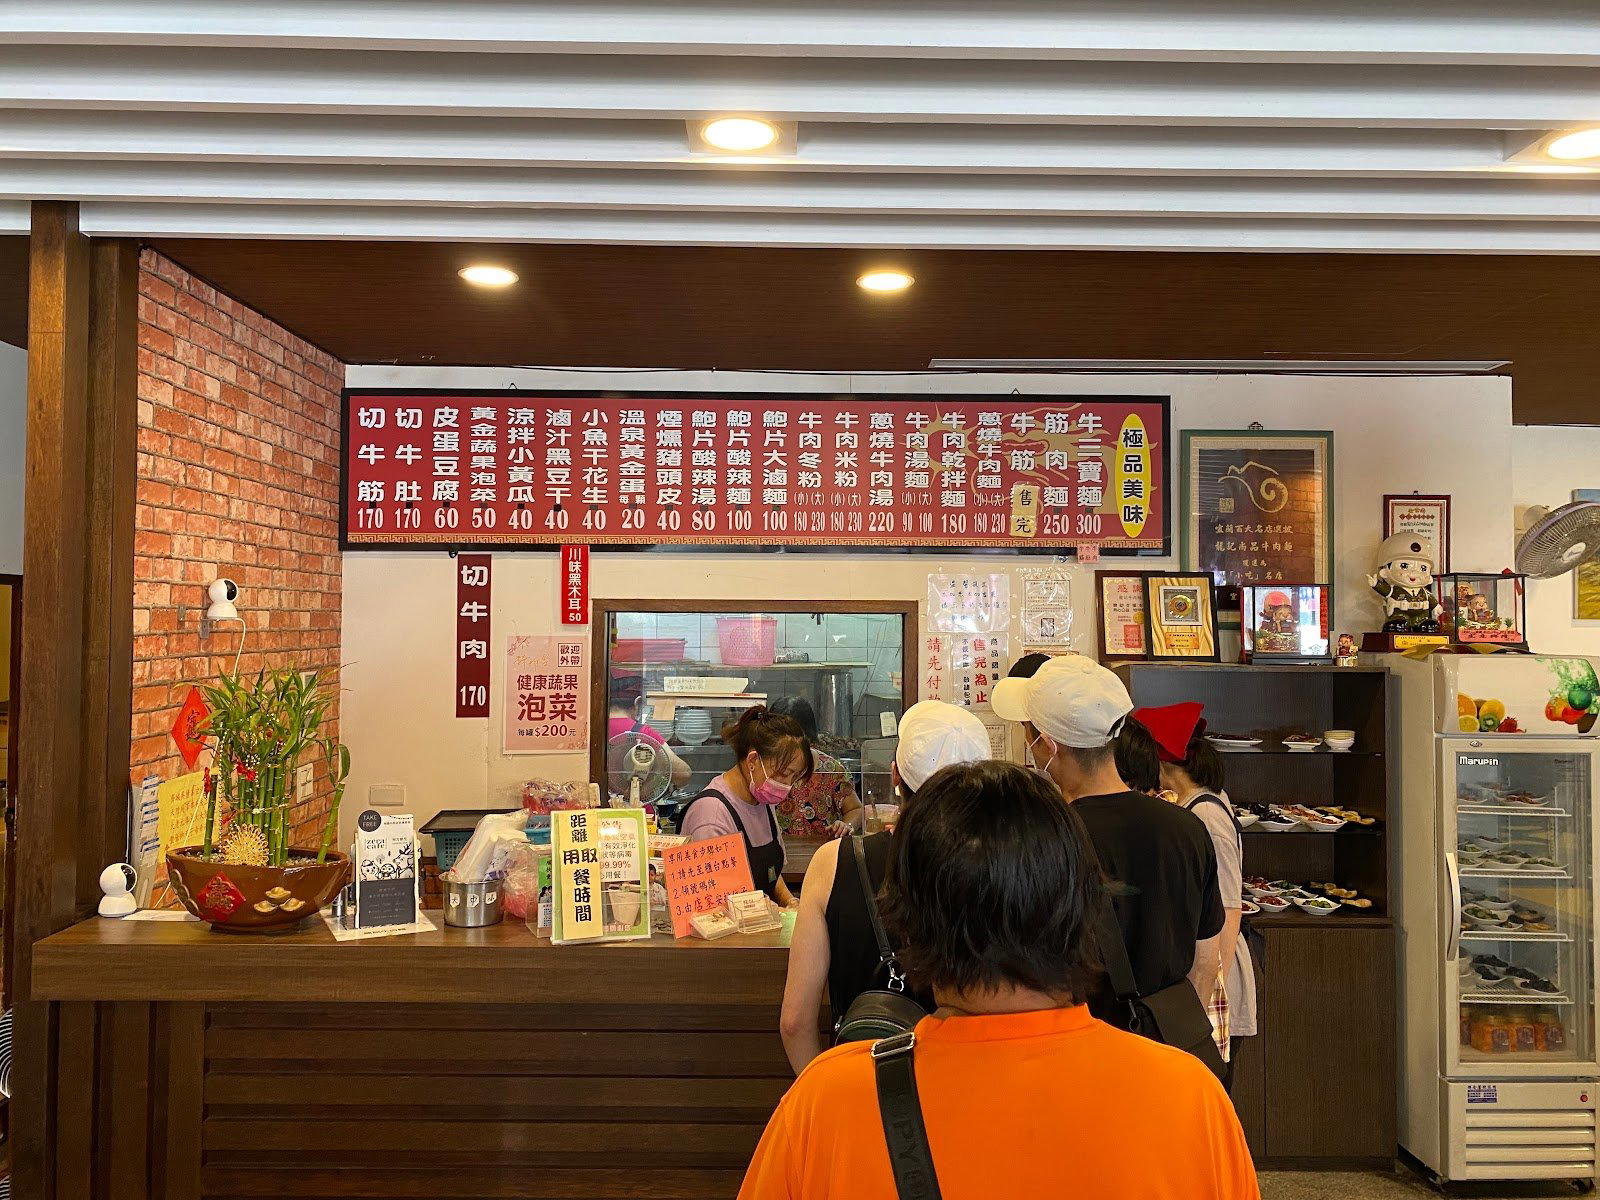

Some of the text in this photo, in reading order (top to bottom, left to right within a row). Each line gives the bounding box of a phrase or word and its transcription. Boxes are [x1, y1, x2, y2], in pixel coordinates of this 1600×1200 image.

[432, 406, 460, 529] 皮蛋豆腐 60
[619, 409, 647, 493] 溫泉黃金蛋
[798, 411, 823, 488] 牛肉冬粉
[834, 411, 860, 488] 牛肉米粉
[904, 411, 930, 488] 牛肉湯麵
[976, 412, 1003, 489] 蔥燒牛肉麵
[1076, 412, 1103, 507] 牛三寶麵
[357, 407, 386, 529] 切牛筋 170
[394, 407, 423, 529] 切牛肚 170
[507, 407, 536, 530] 涼拌小黃瓜 40
[544, 408, 572, 530] 滷汁黑豆干 40
[582, 408, 609, 530] 小魚干花生 40
[656, 410, 683, 531] 煙燻豬頭皮 40
[691, 410, 717, 531] 鮑片酸辣湯 80
[1043, 412, 1070, 535] 筋肉麵 250
[1122, 428, 1144, 524] 極品美味
[471, 507, 497, 529] 50
[621, 508, 646, 529] 20
[726, 510, 752, 531] 100
[762, 510, 788, 531] 100
[793, 511, 808, 532] 180
[811, 511, 826, 532] 230
[830, 511, 844, 532] 180
[848, 511, 862, 532] 230
[868, 511, 895, 532] 220
[902, 511, 913, 532] 90
[918, 512, 933, 532] 100
[941, 513, 967, 534] 180
[973, 512, 988, 533] 180
[991, 513, 1006, 534] 230
[1015, 489, 1032, 533] 售完
[1076, 513, 1102, 535] 300
[568, 547, 583, 622] 川味黑木耳 50
[460, 565, 488, 707] 切牛肉 170
[559, 644, 580, 655] 歡迎
[559, 655, 580, 666] 外帶
[973, 638, 988, 703] 售完為止
[516, 674, 578, 691] 健康蔬果
[517, 692, 577, 721] 泡菜
[1459, 756, 1499, 766] Marupin
